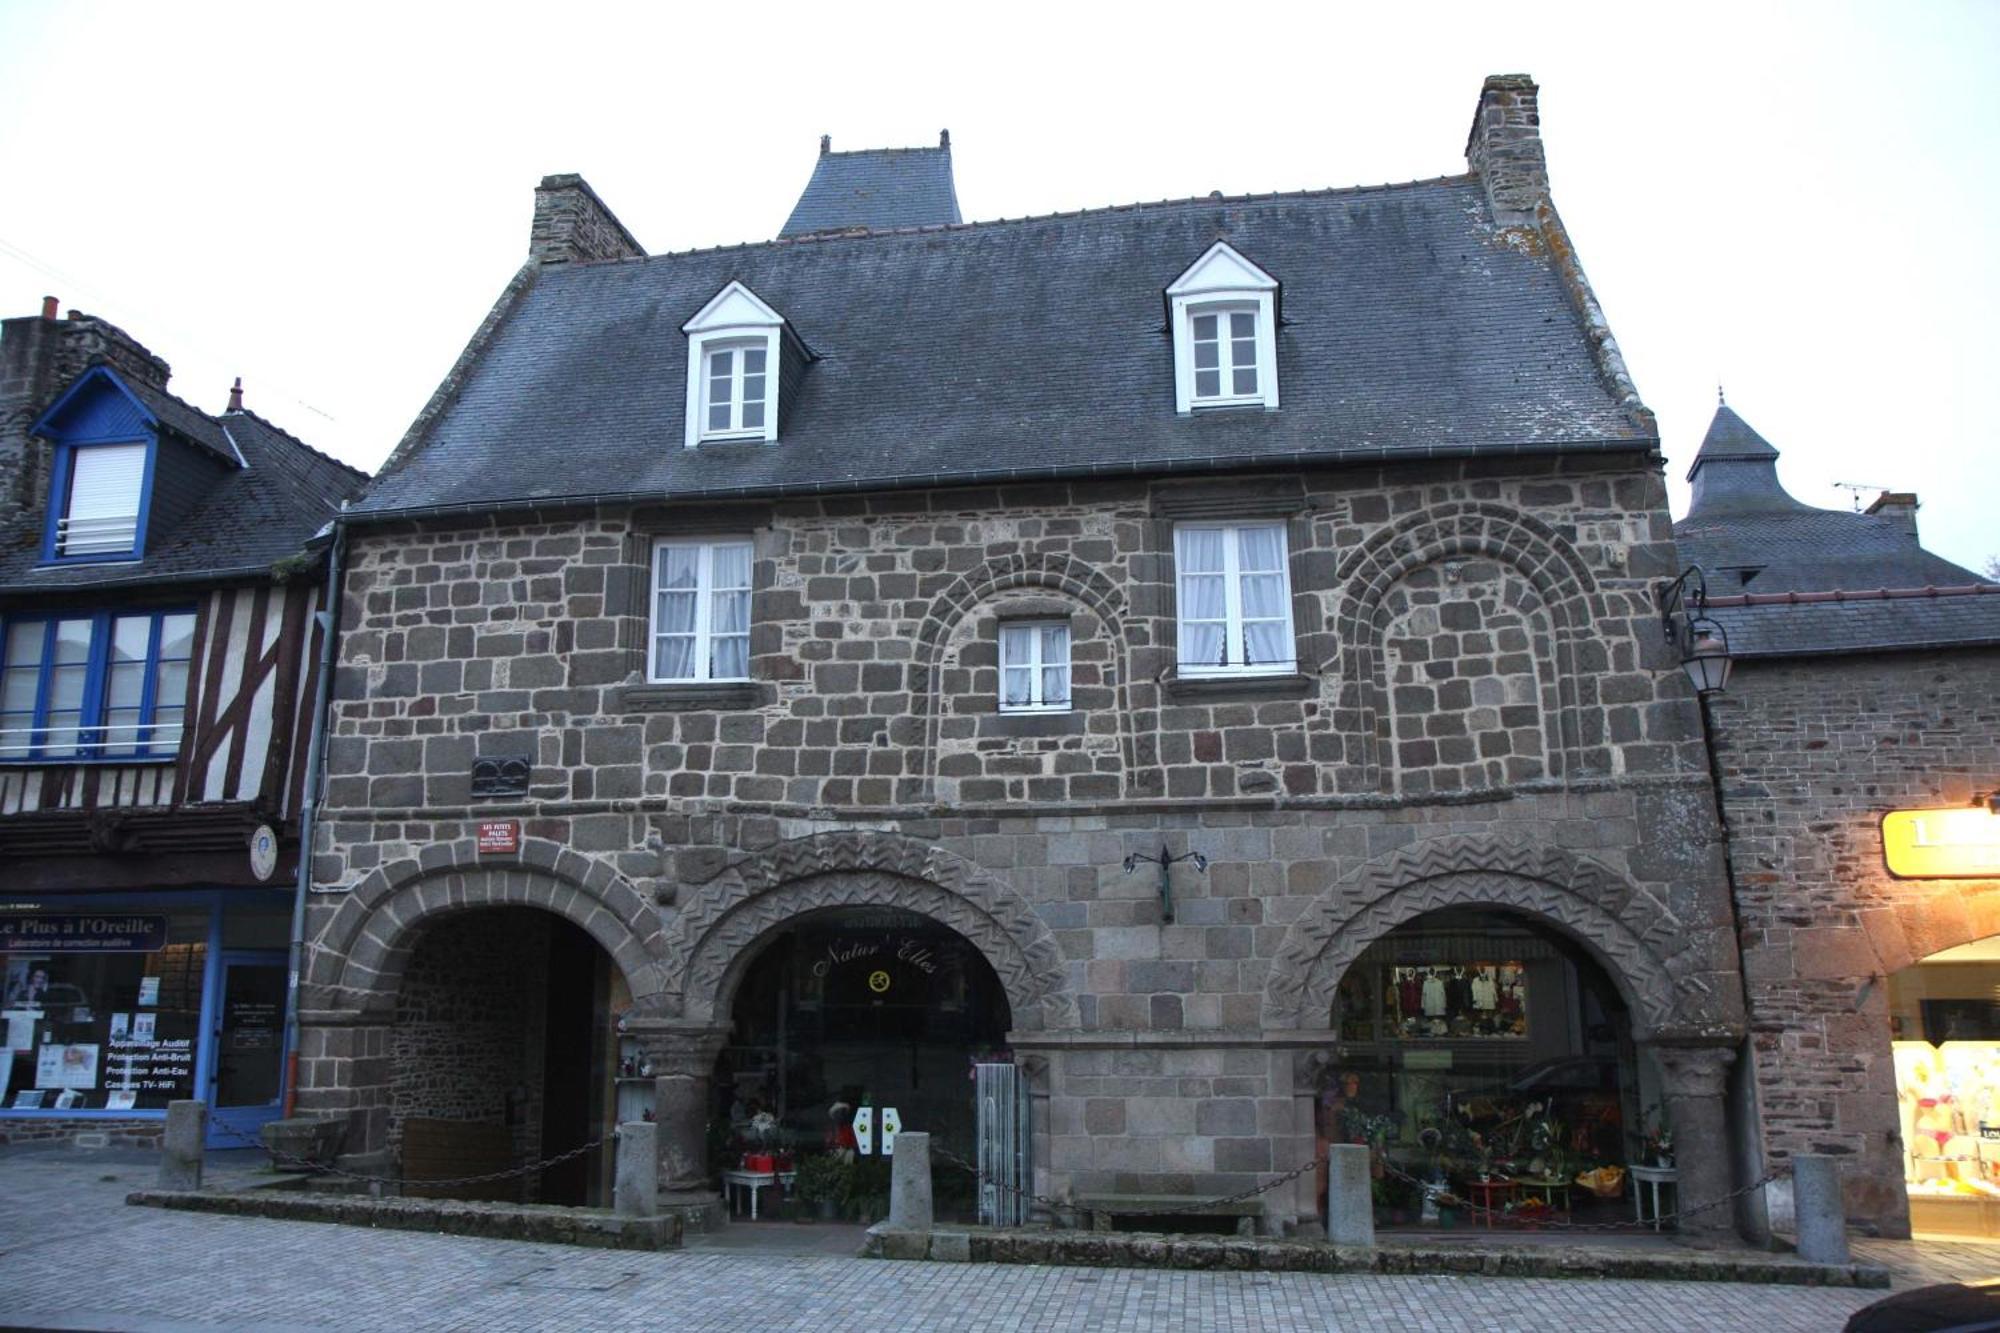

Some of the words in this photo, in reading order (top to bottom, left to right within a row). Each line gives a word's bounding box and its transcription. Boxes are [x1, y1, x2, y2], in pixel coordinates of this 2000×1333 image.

[0, 921, 15, 934] e
[20, 919, 59, 934] Plus
[63, 919, 74, 934] à
[79, 919, 155, 934] l'Oreille
[162, 1039, 190, 1048] Auditif
[107, 1053, 150, 1061] Protection
[151, 1053, 191, 1061] Anti-Bruit
[152, 1067, 188, 1075] Anti-Eau
